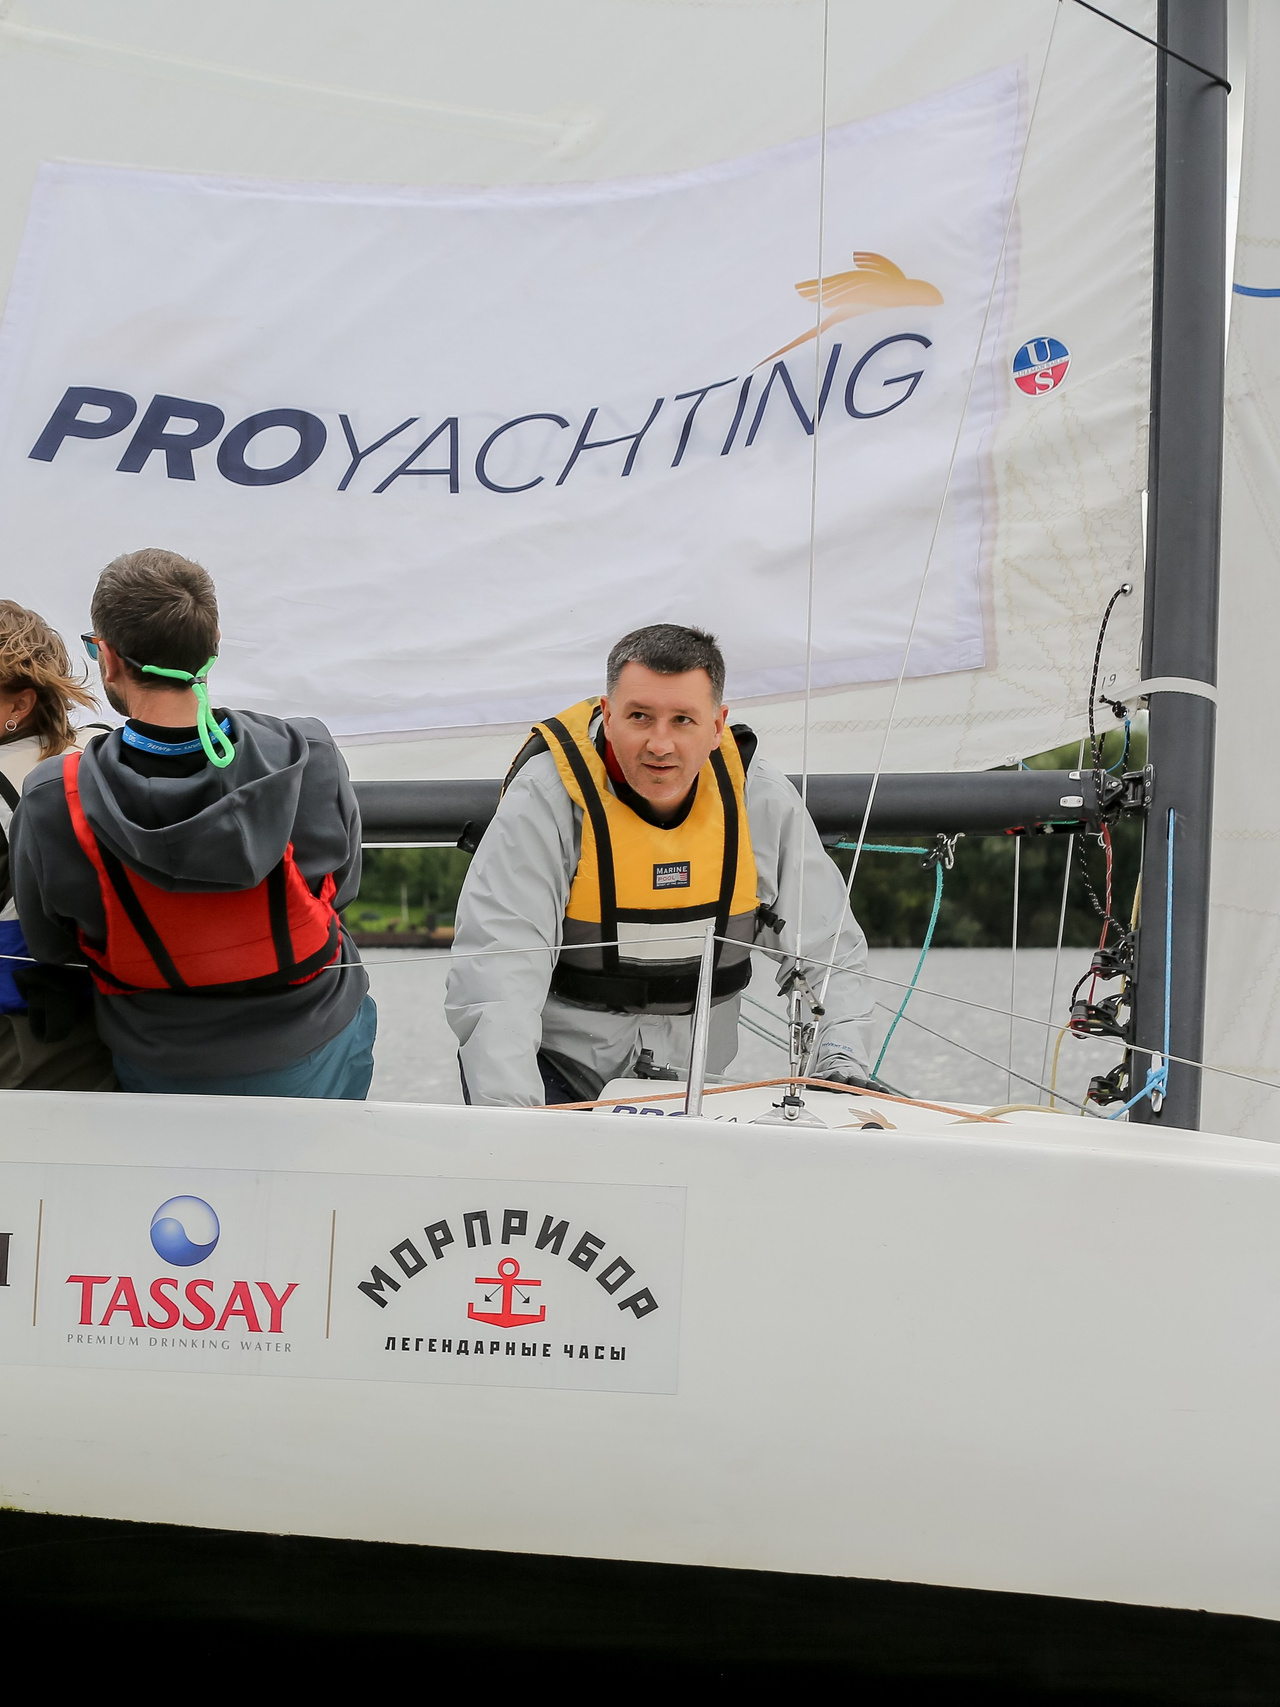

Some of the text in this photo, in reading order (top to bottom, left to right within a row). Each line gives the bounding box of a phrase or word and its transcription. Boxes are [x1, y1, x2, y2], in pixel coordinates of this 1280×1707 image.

[28, 333, 933, 495] PROYACHTING
[656, 866, 687, 874] MARINE
[357, 1209, 659, 1319] МОРПРИБОР
[65, 1275, 300, 1334] TASSAY
[67, 1333, 293, 1353] PREMIUM DRINKING WATER
[384, 1336, 626, 1361] ЛЕГЕНДАРНЫЕ ЧАСЫ
